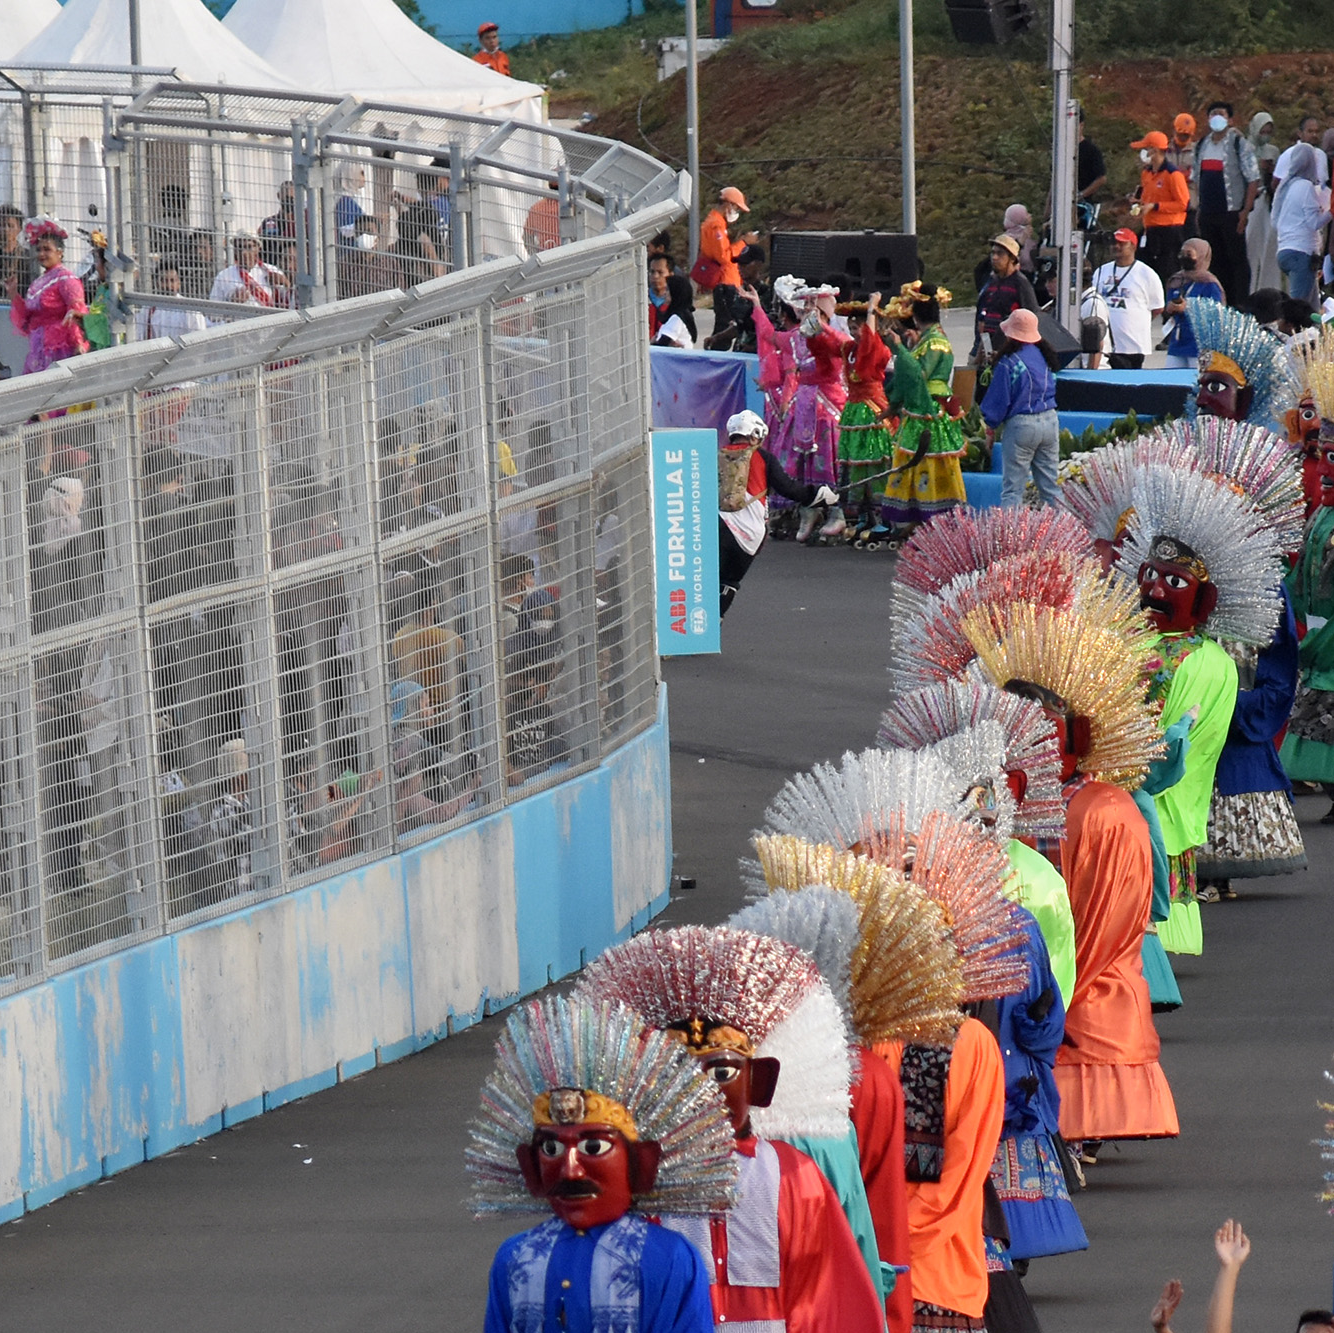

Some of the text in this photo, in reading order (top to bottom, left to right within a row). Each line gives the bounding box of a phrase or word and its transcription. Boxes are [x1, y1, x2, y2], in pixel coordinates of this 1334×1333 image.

[665, 449, 687, 635] ABB FORMULA E
[690, 448, 703, 551] CHAMPIONSHIP
[693, 555, 703, 603] WORLD
